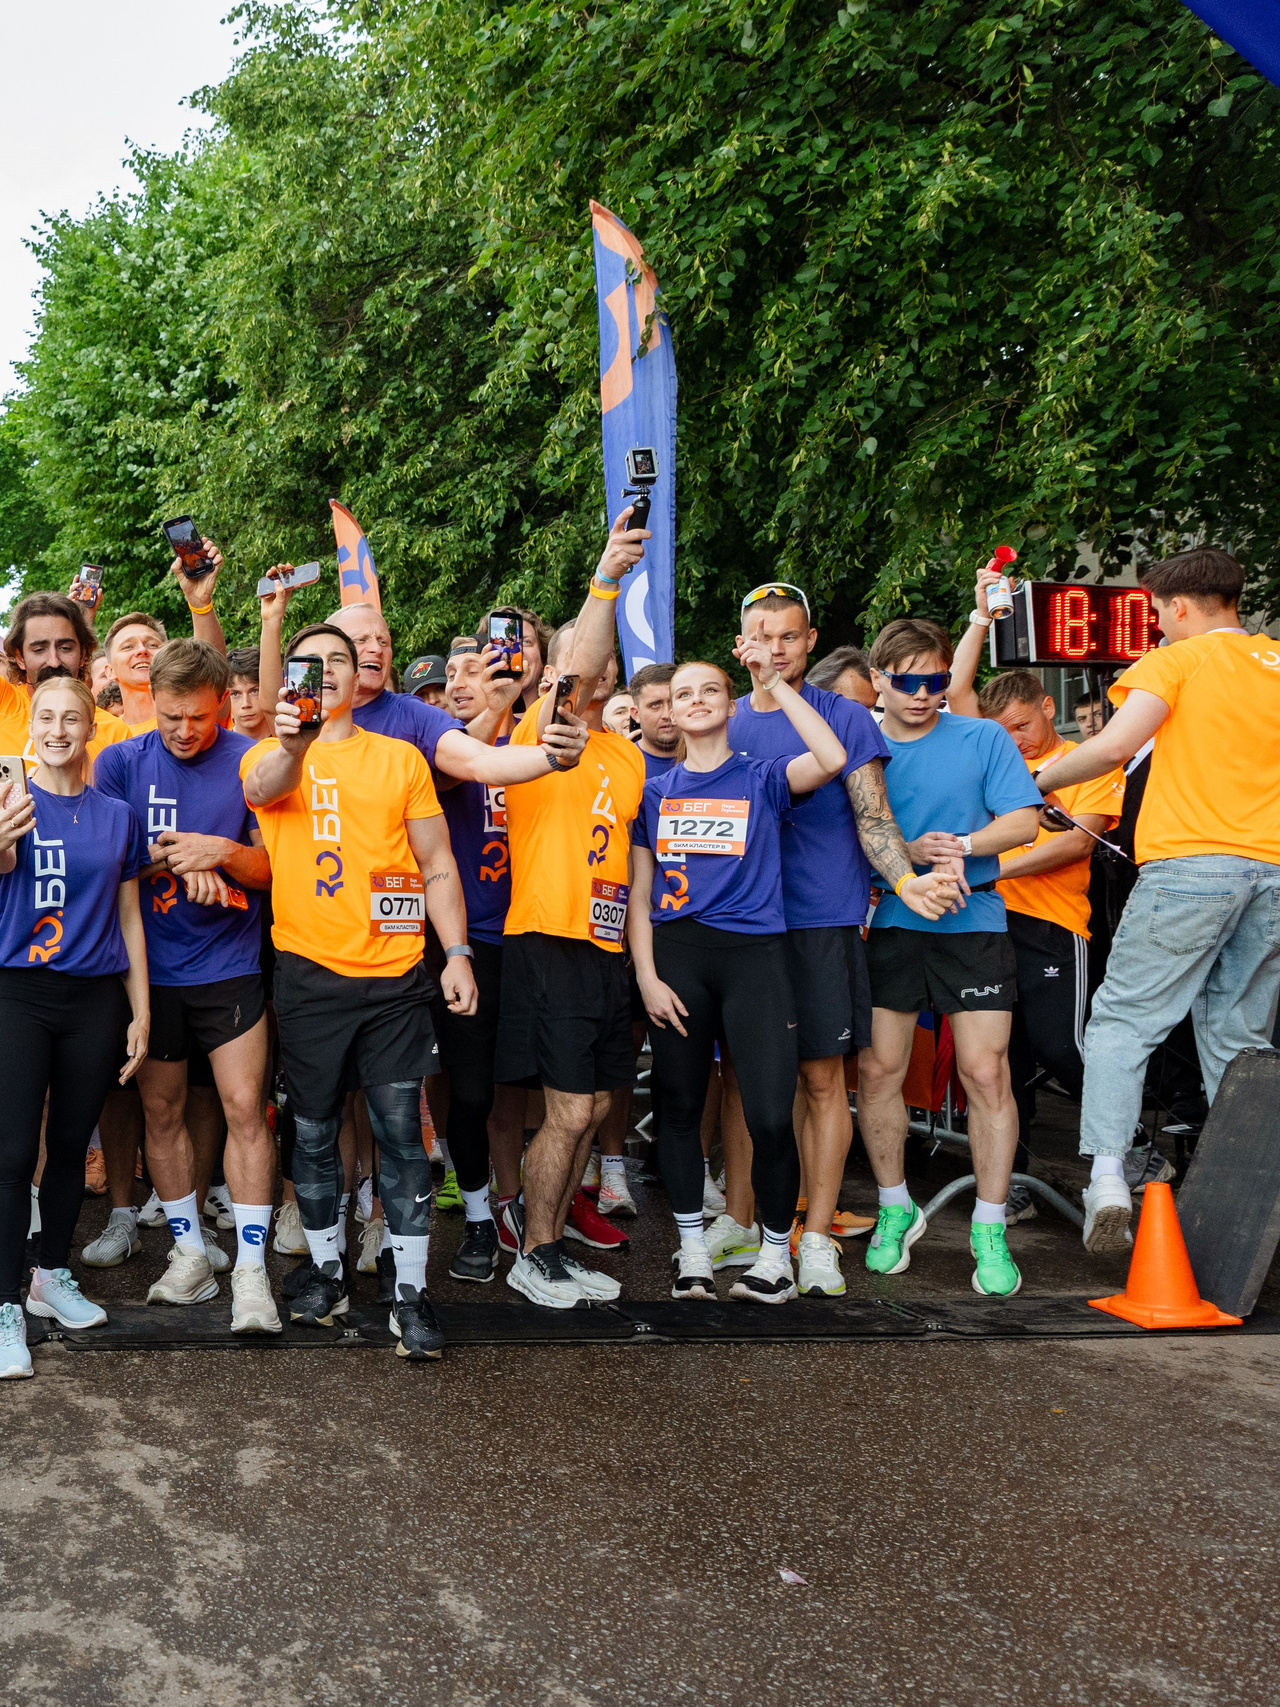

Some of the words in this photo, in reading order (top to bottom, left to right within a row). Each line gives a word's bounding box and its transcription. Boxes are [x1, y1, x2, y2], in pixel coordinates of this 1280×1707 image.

[308, 764, 341, 843] БЕГ
[682, 802, 712, 813] БЕГ
[147, 785, 177, 846] ЕГ
[669, 819, 735, 838] 1272
[33, 827, 66, 909] БЕГ
[385, 876, 405, 888] БЕГ
[602, 884, 617, 897] БЕГ
[379, 896, 420, 916] 0771
[592, 902, 625, 925] 0307
